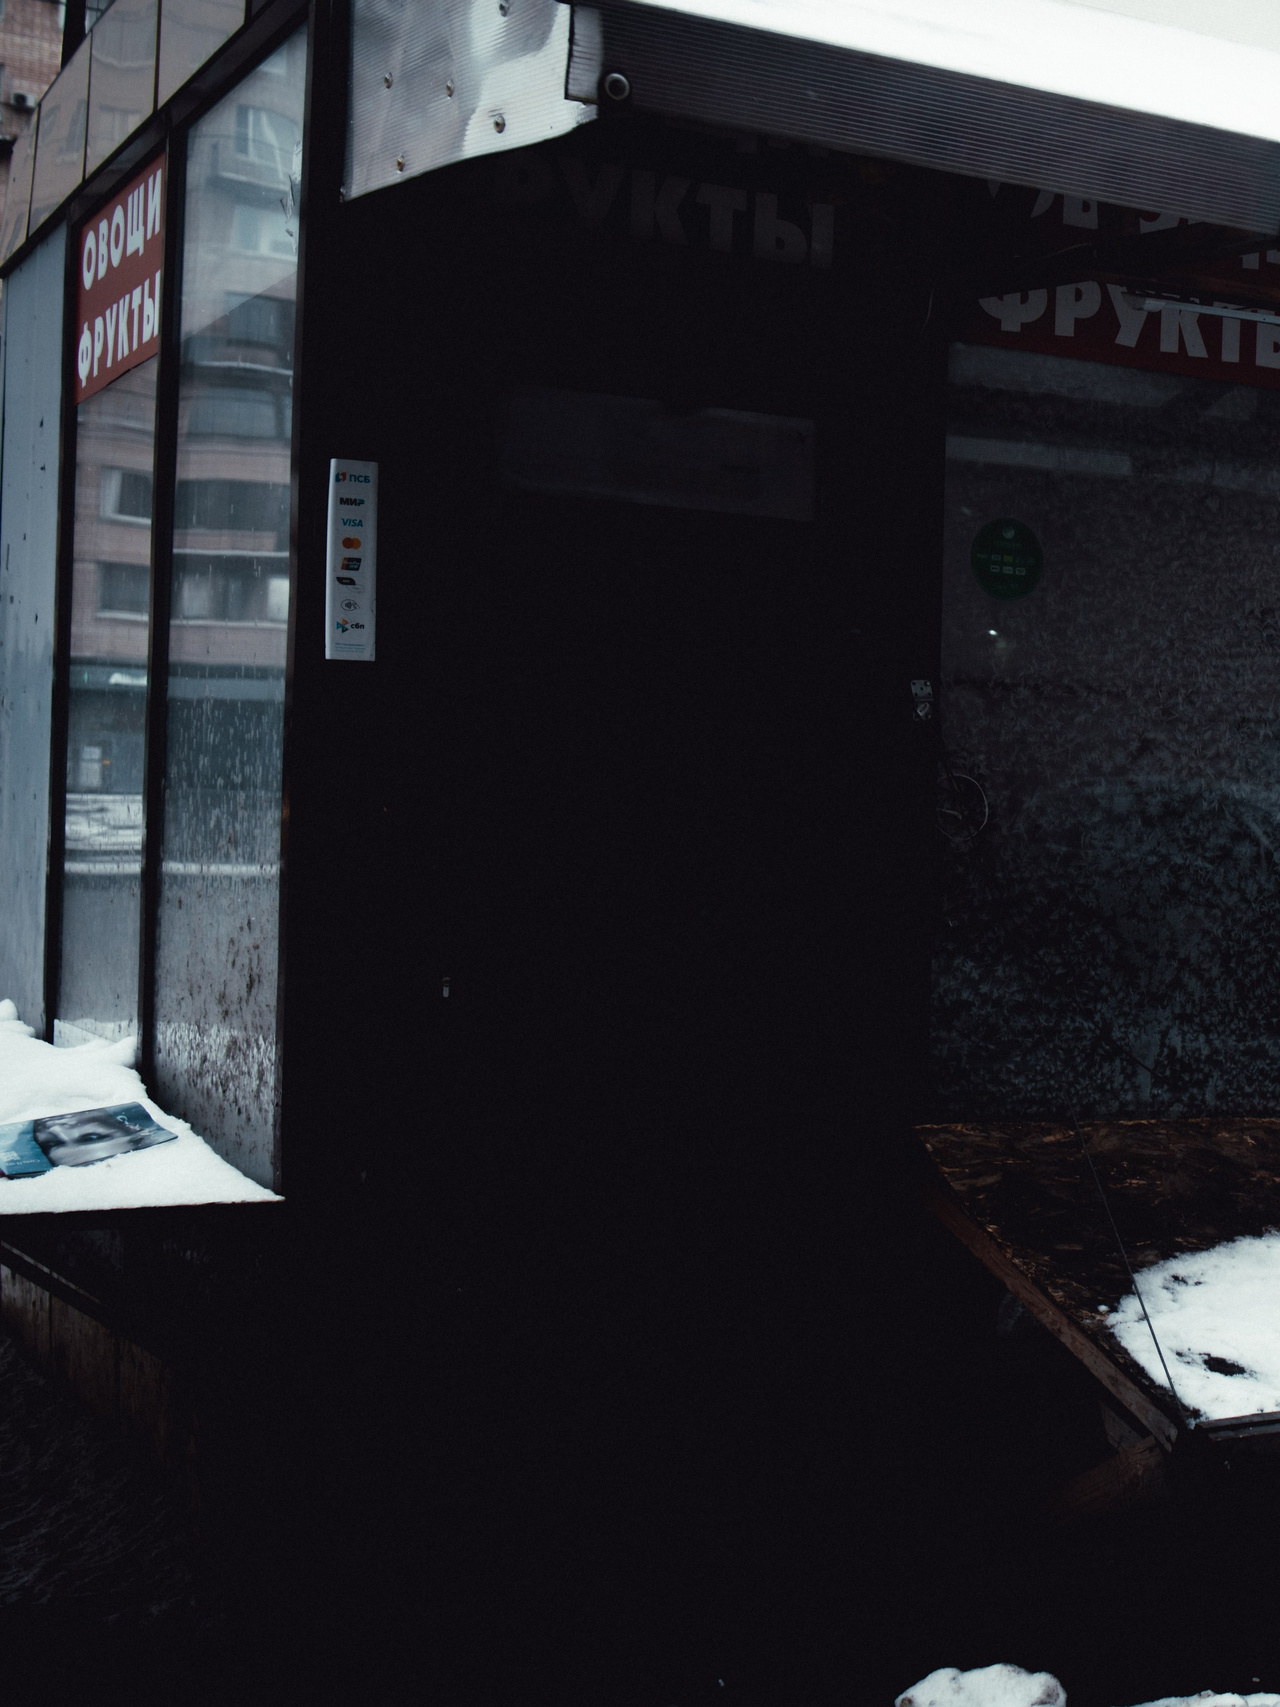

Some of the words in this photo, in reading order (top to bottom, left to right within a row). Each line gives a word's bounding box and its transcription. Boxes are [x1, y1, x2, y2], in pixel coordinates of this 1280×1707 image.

[83, 168, 162, 291] ОВОЩИ
[78, 269, 161, 388] ФРУКТЫ
[349, 474, 371, 484] ПСБ
[340, 497, 365, 507] МИР
[341, 518, 364, 528] VISA
